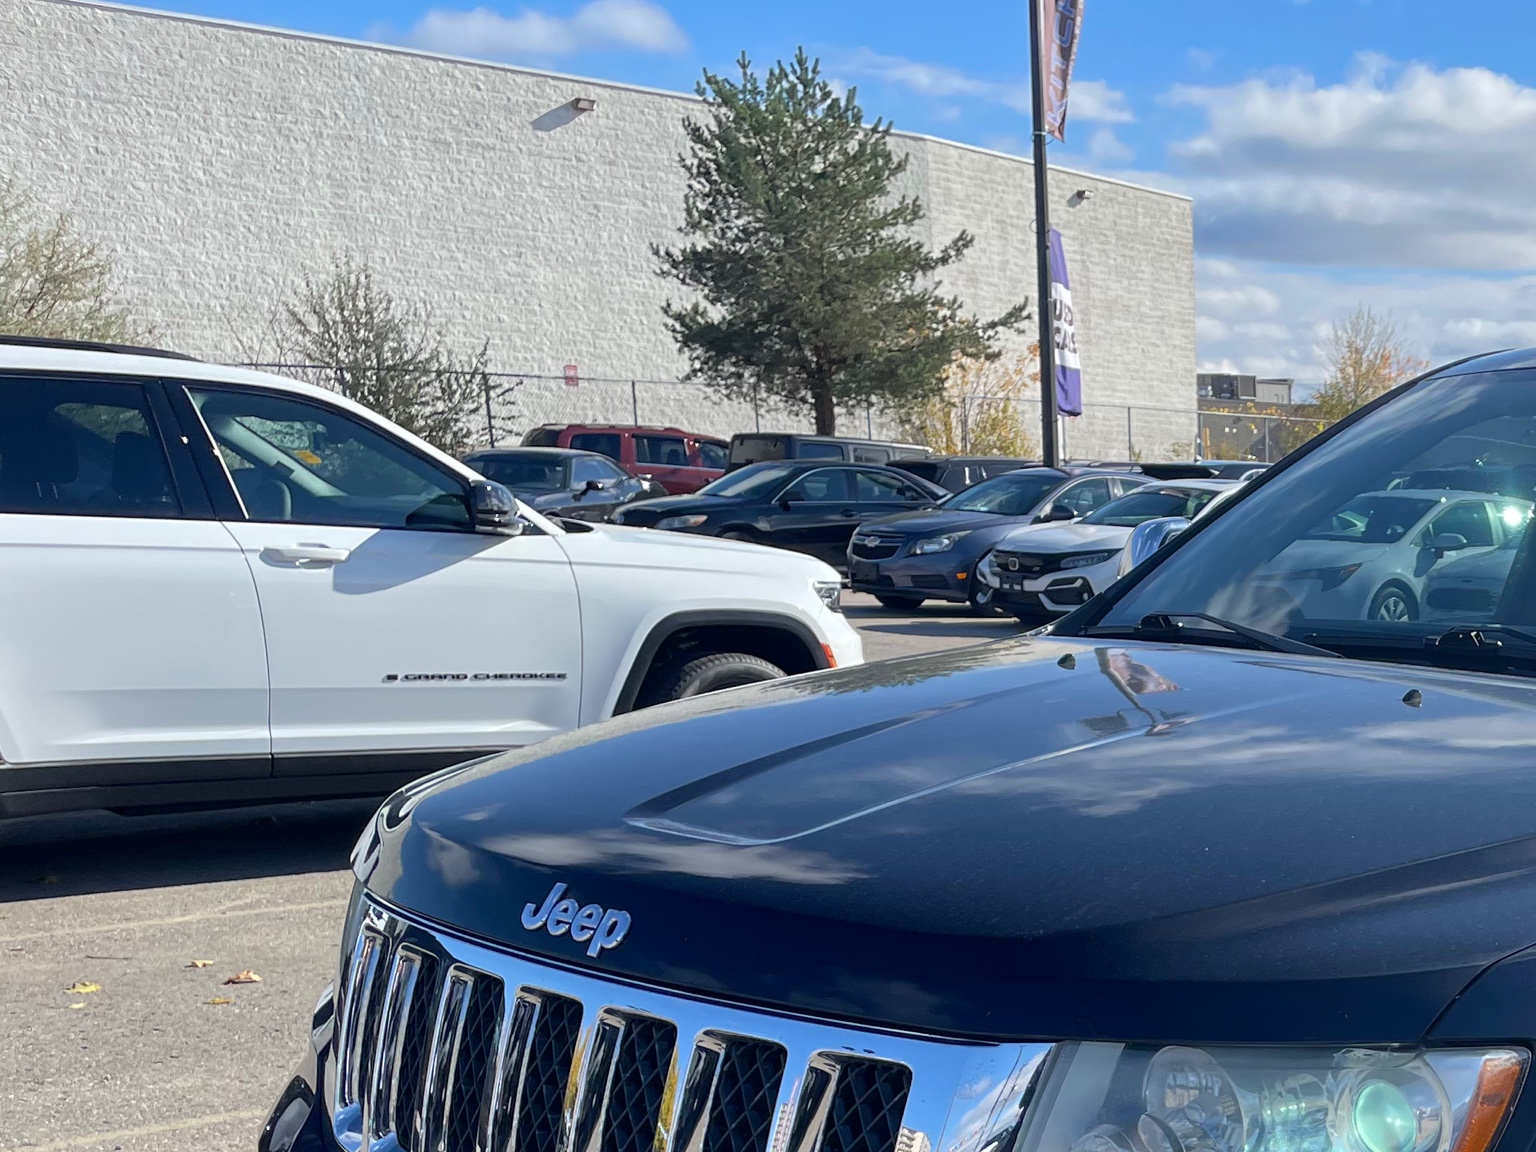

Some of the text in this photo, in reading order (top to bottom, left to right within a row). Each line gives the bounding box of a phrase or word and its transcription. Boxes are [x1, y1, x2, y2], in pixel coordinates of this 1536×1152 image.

[401, 672, 568, 682] GRAND CHEROKEE
[521, 882, 632, 958] Jeep
